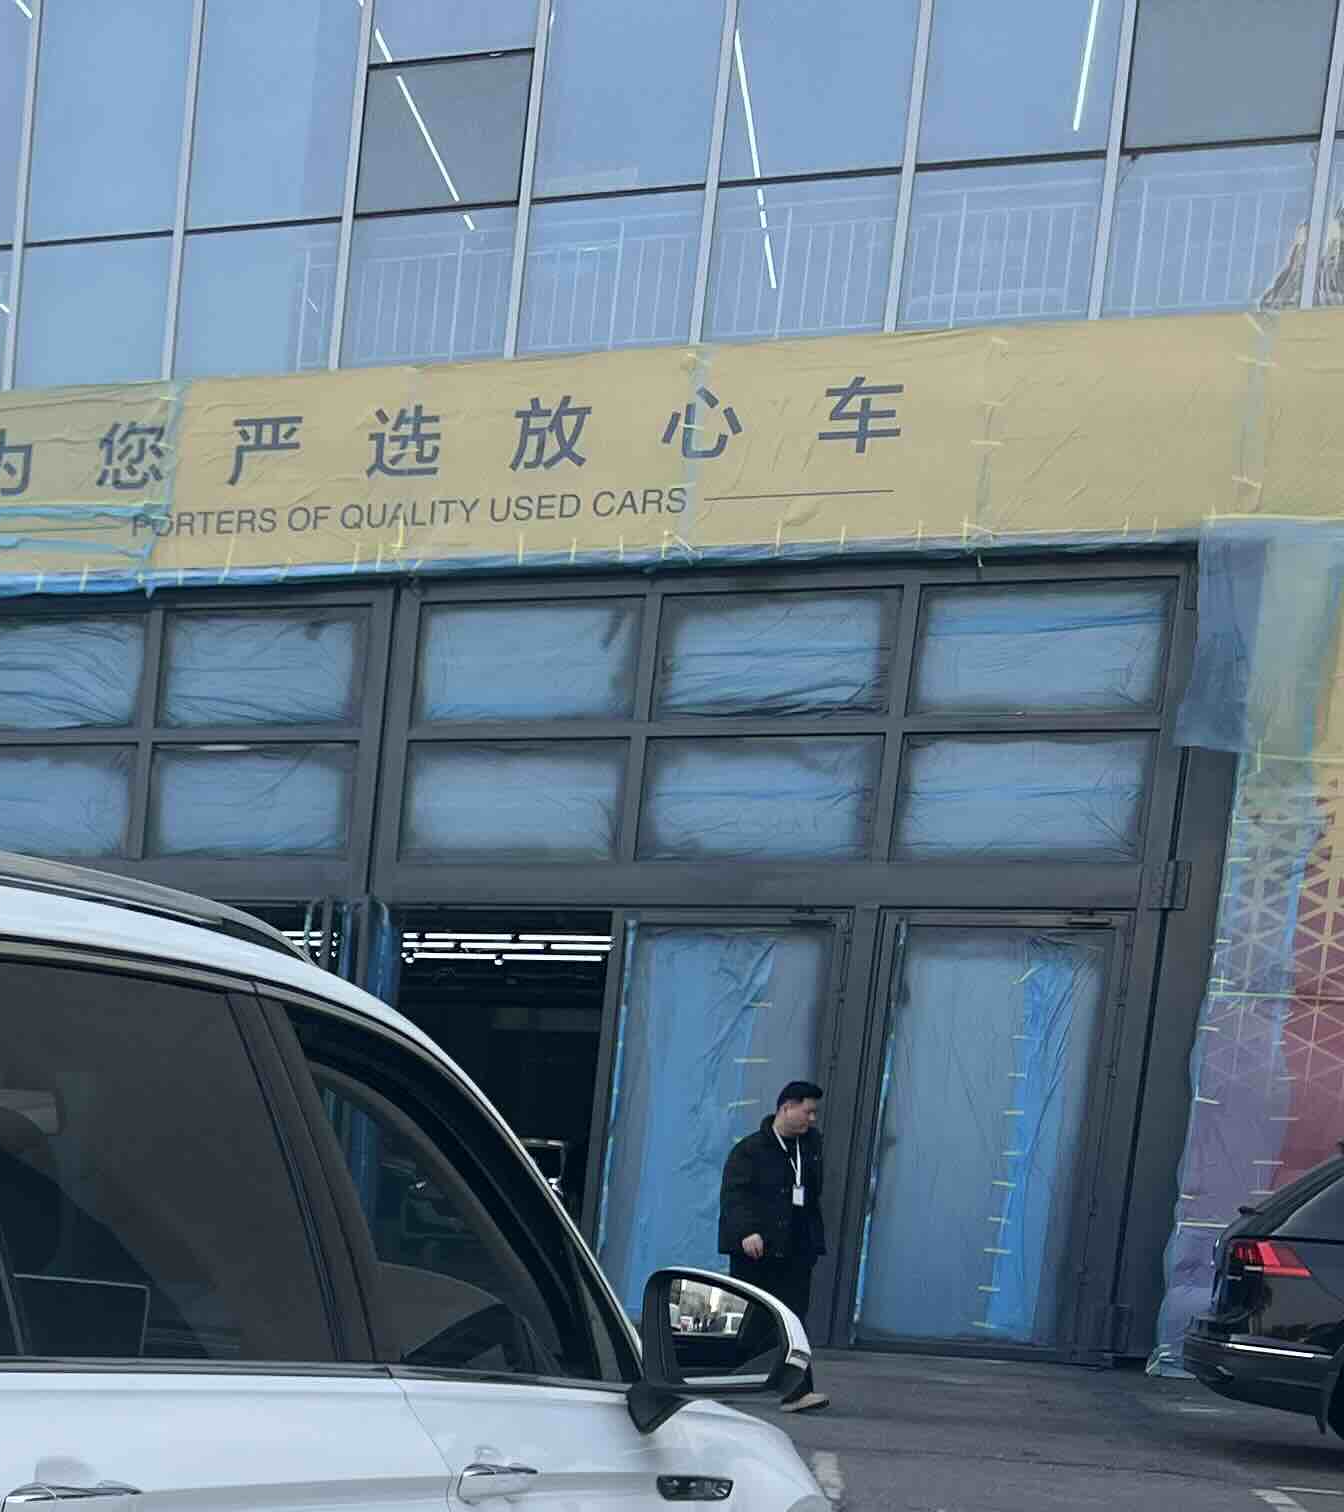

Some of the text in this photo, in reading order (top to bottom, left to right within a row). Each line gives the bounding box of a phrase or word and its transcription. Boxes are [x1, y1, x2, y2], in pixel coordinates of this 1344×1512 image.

[286, 505, 332, 531] OF
[339, 497, 480, 530] QUALITY
[489, 493, 581, 522] USED
[592, 487, 687, 517] CARS
